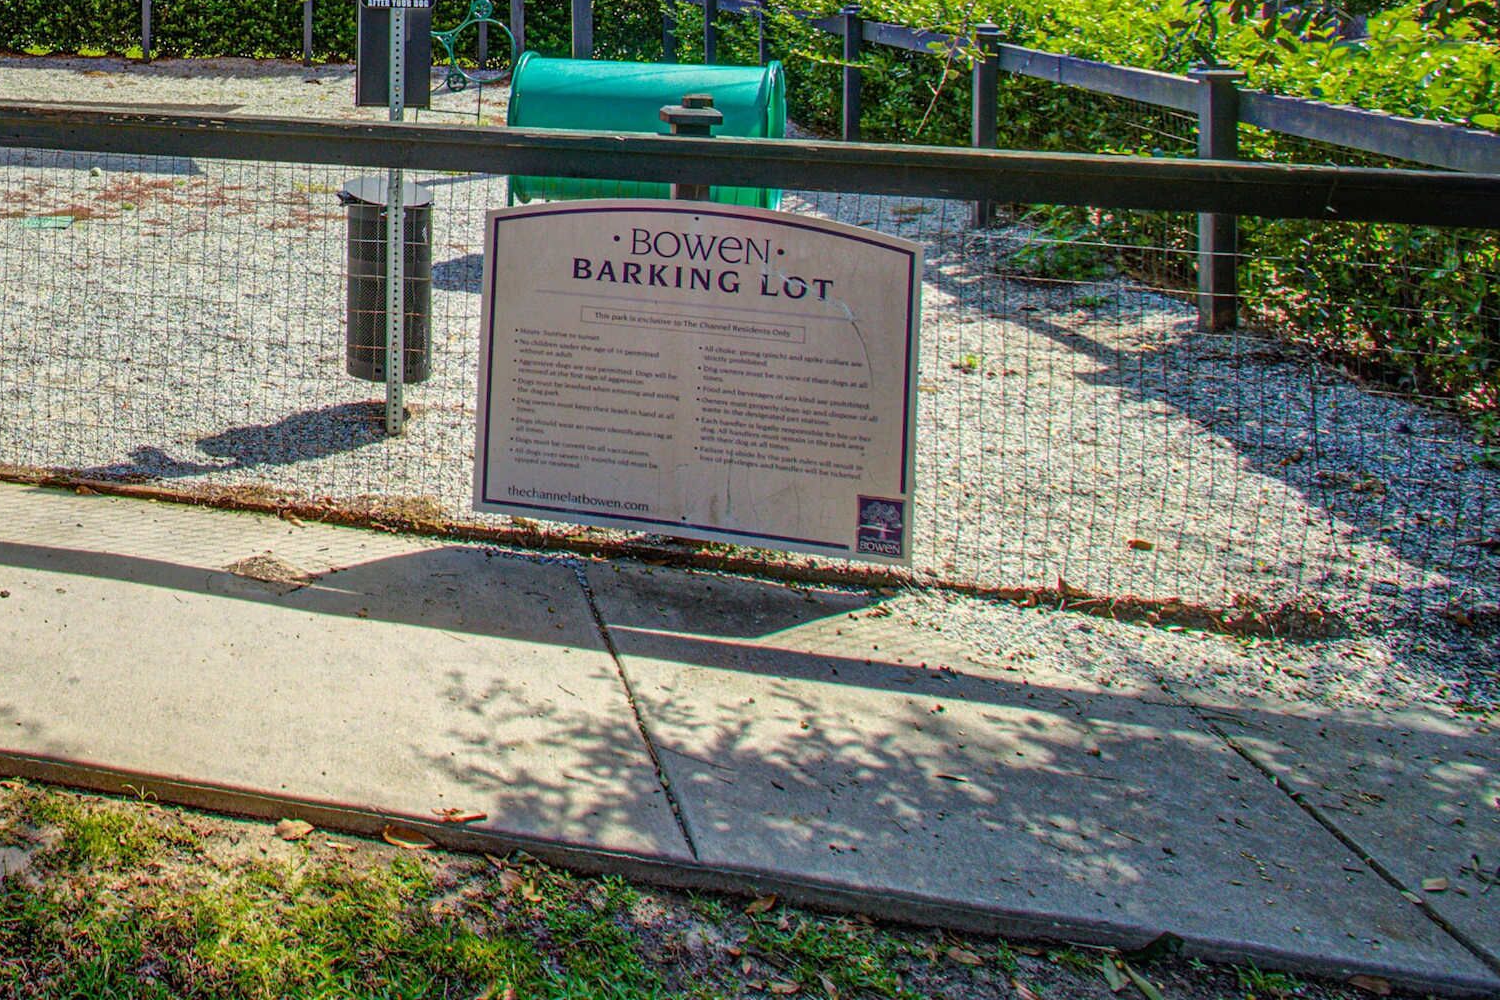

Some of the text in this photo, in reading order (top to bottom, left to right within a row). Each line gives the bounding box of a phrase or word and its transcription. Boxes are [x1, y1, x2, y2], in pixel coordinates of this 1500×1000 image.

[368, 0, 429, 7] AFTER YOUR DOG
[573, 258, 834, 300] BARKING LOT
[699, 321, 731, 331] Channel
[732, 324, 770, 335] Residents
[507, 485, 649, 512] thechannelatbowen.com
